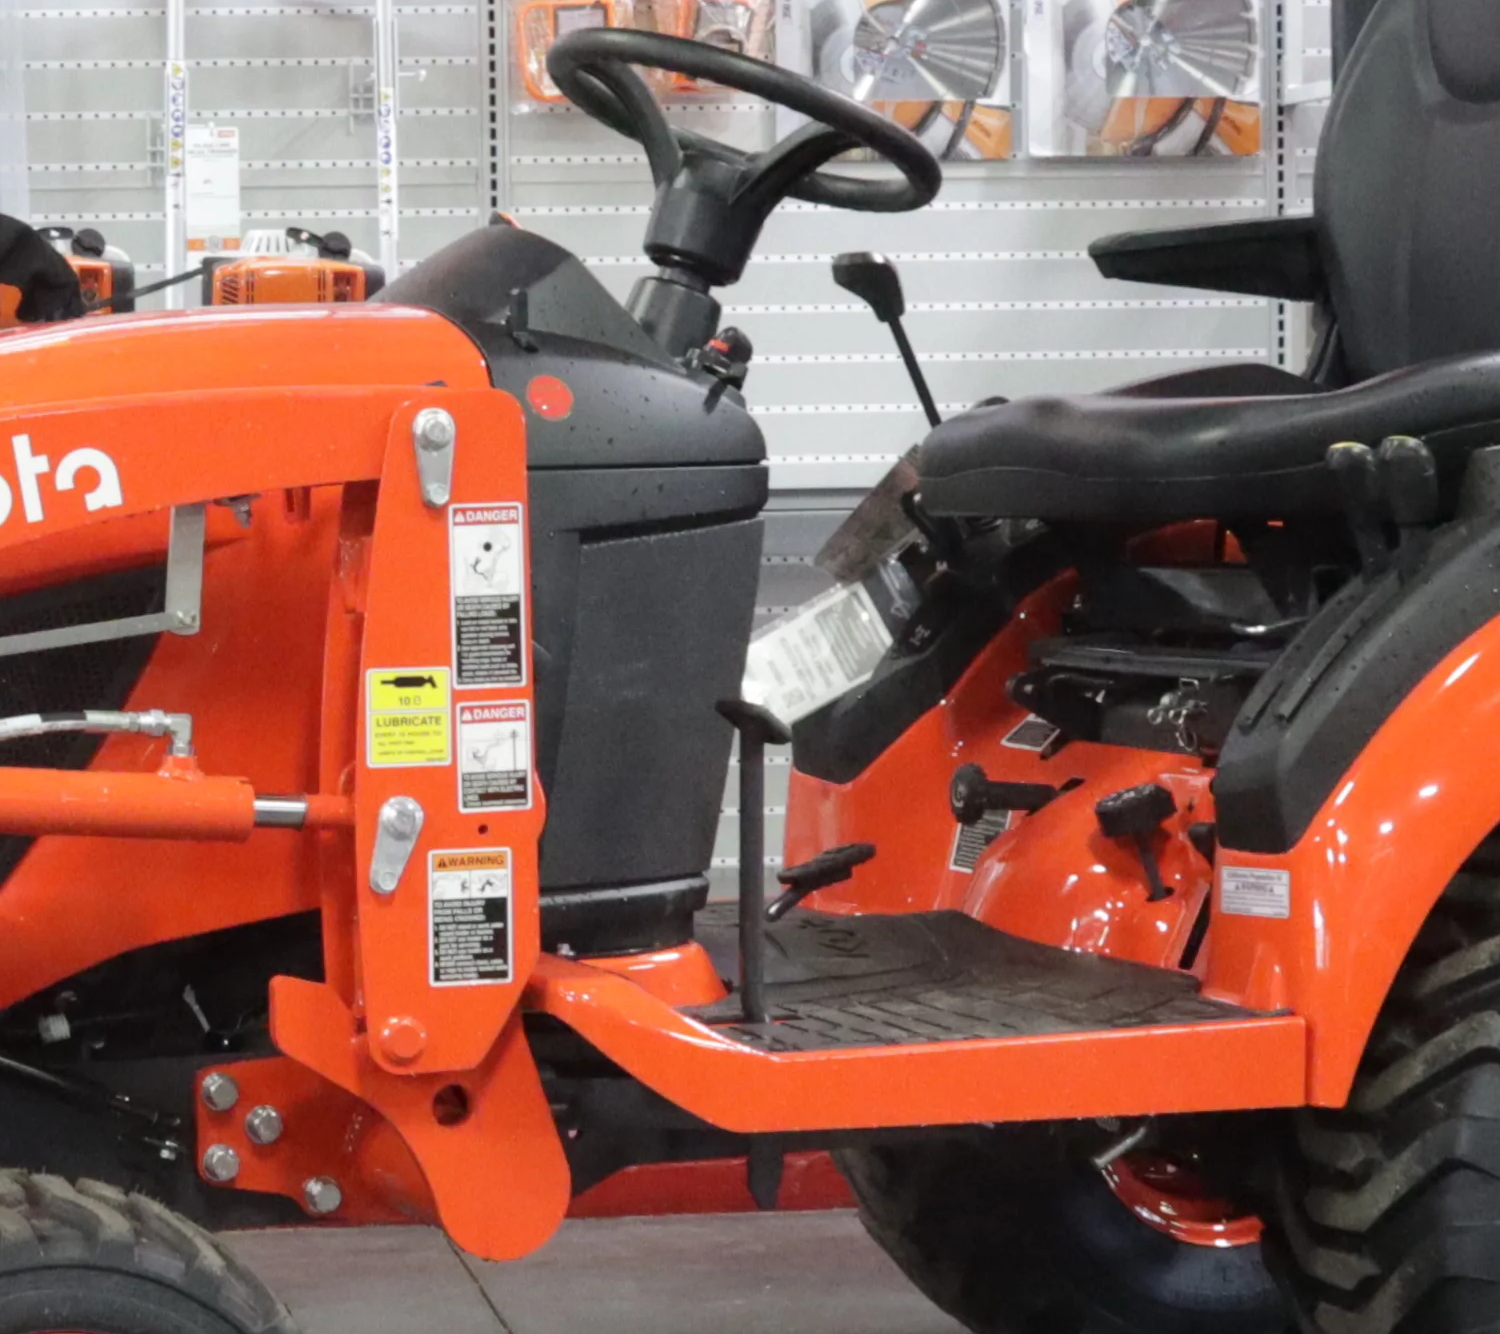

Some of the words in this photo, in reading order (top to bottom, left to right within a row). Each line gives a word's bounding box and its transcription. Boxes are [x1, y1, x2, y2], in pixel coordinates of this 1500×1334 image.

[466, 509, 518, 523] DANGER
[399, 695, 411, 706] 10
[473, 707, 525, 721] DANGER
[376, 715, 442, 728] LUBRICATE
[449, 854, 504, 867] WARNING
